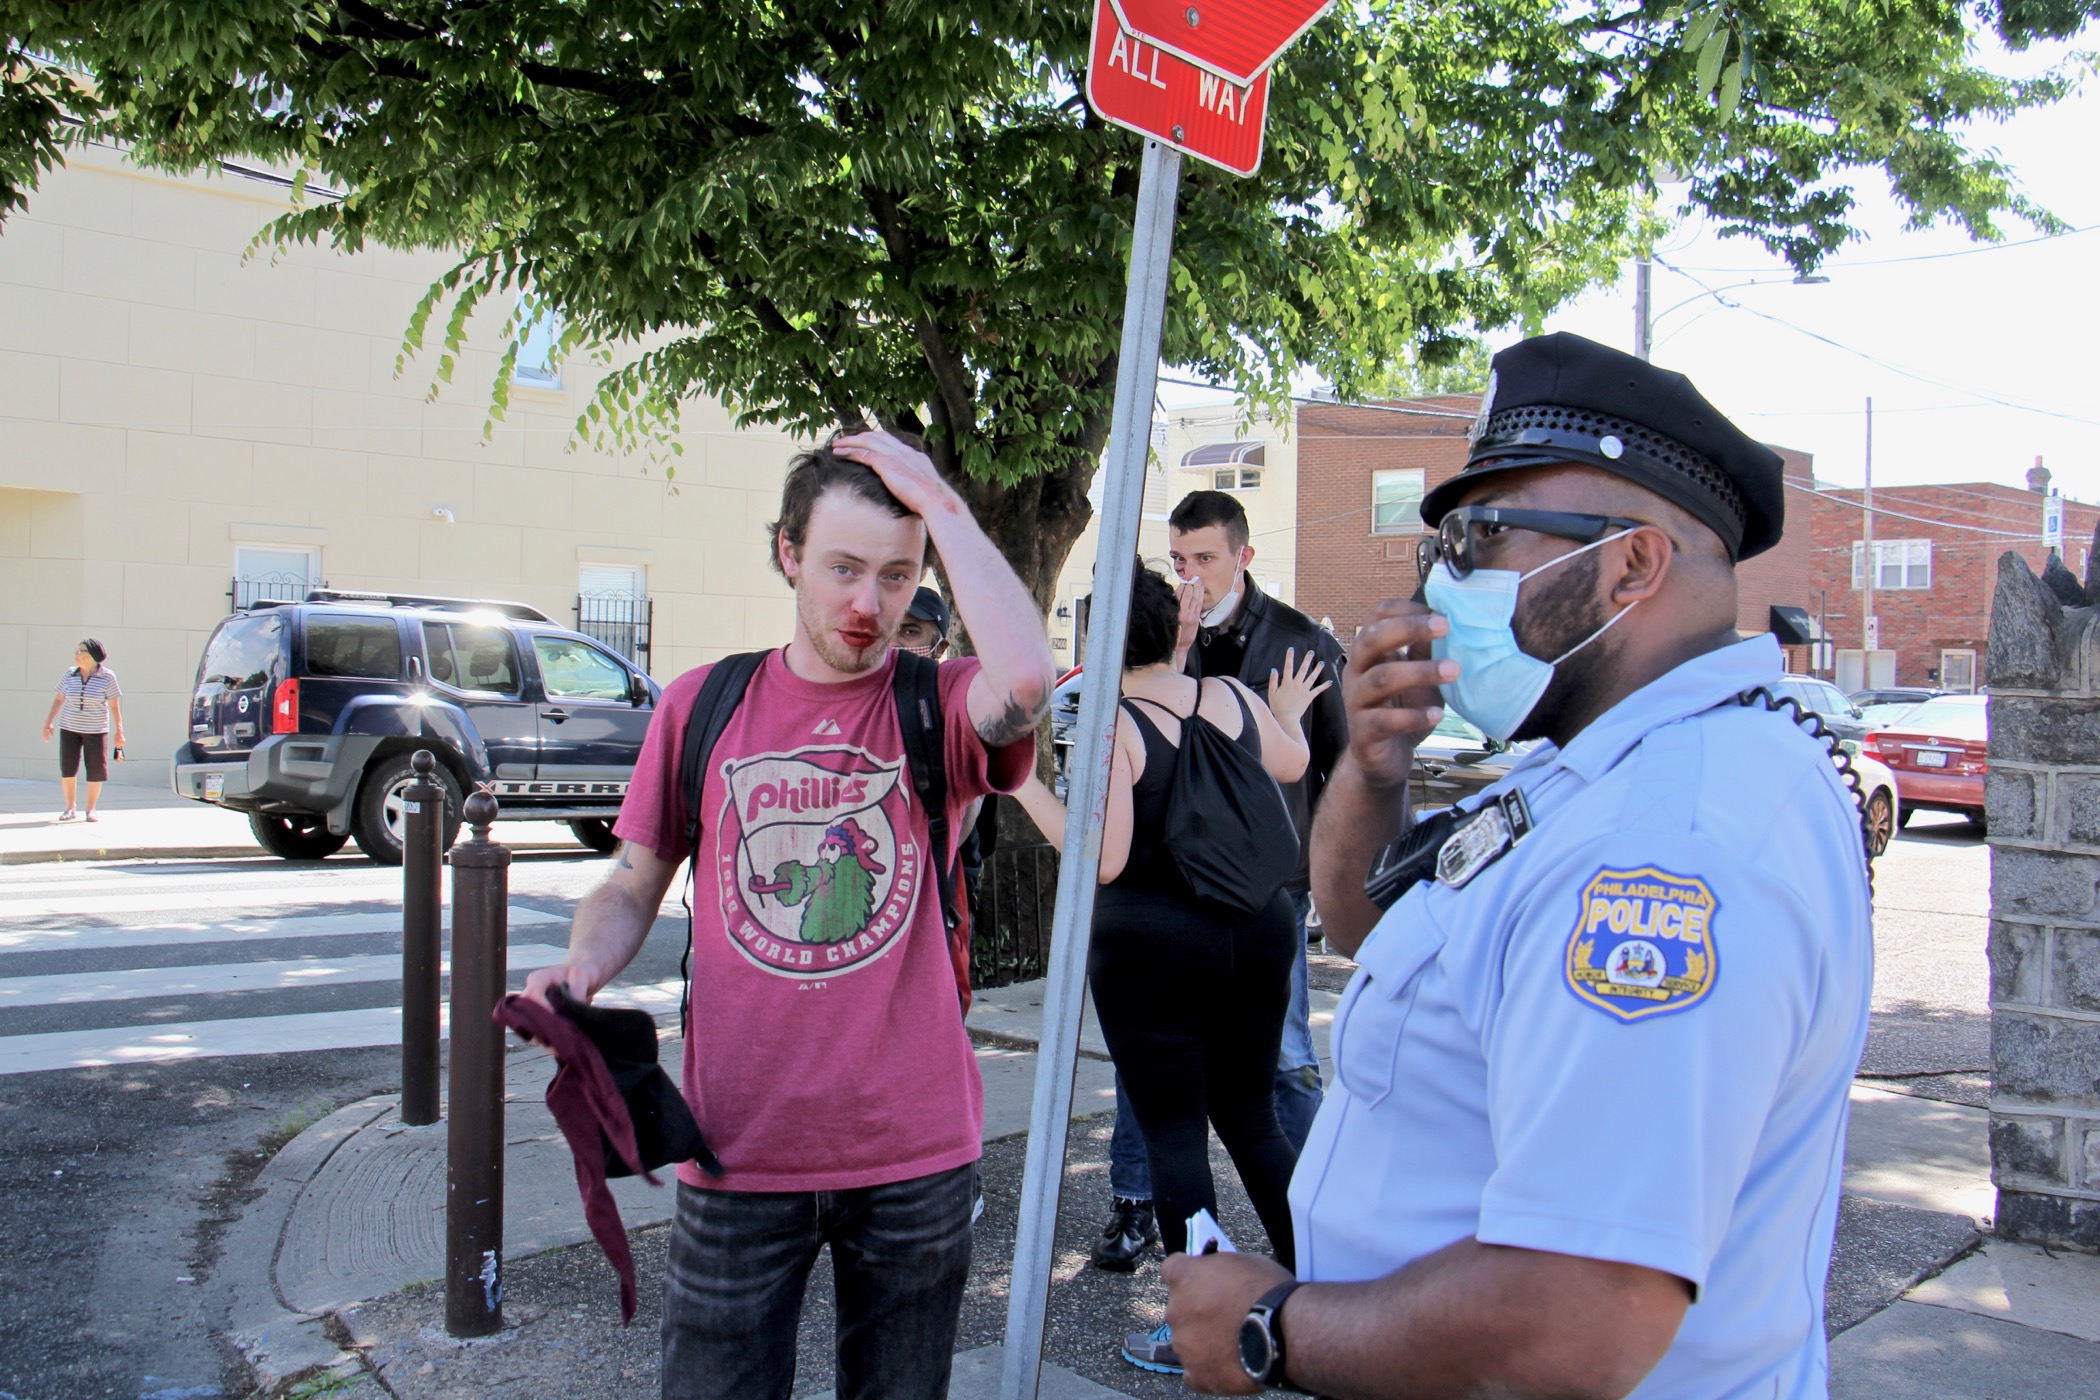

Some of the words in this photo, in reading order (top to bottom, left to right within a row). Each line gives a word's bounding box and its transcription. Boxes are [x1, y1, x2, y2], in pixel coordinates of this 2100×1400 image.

[1108, 27, 1166, 90] ALL
[1200, 70, 1254, 126] WAY
[475, 780, 629, 794] XTERR
[738, 920, 813, 965] WORLD
[827, 842, 914, 962] CHAMPIONS
[1594, 883, 1706, 907] PHILADELPHIA
[1586, 898, 1706, 944] POLICE
